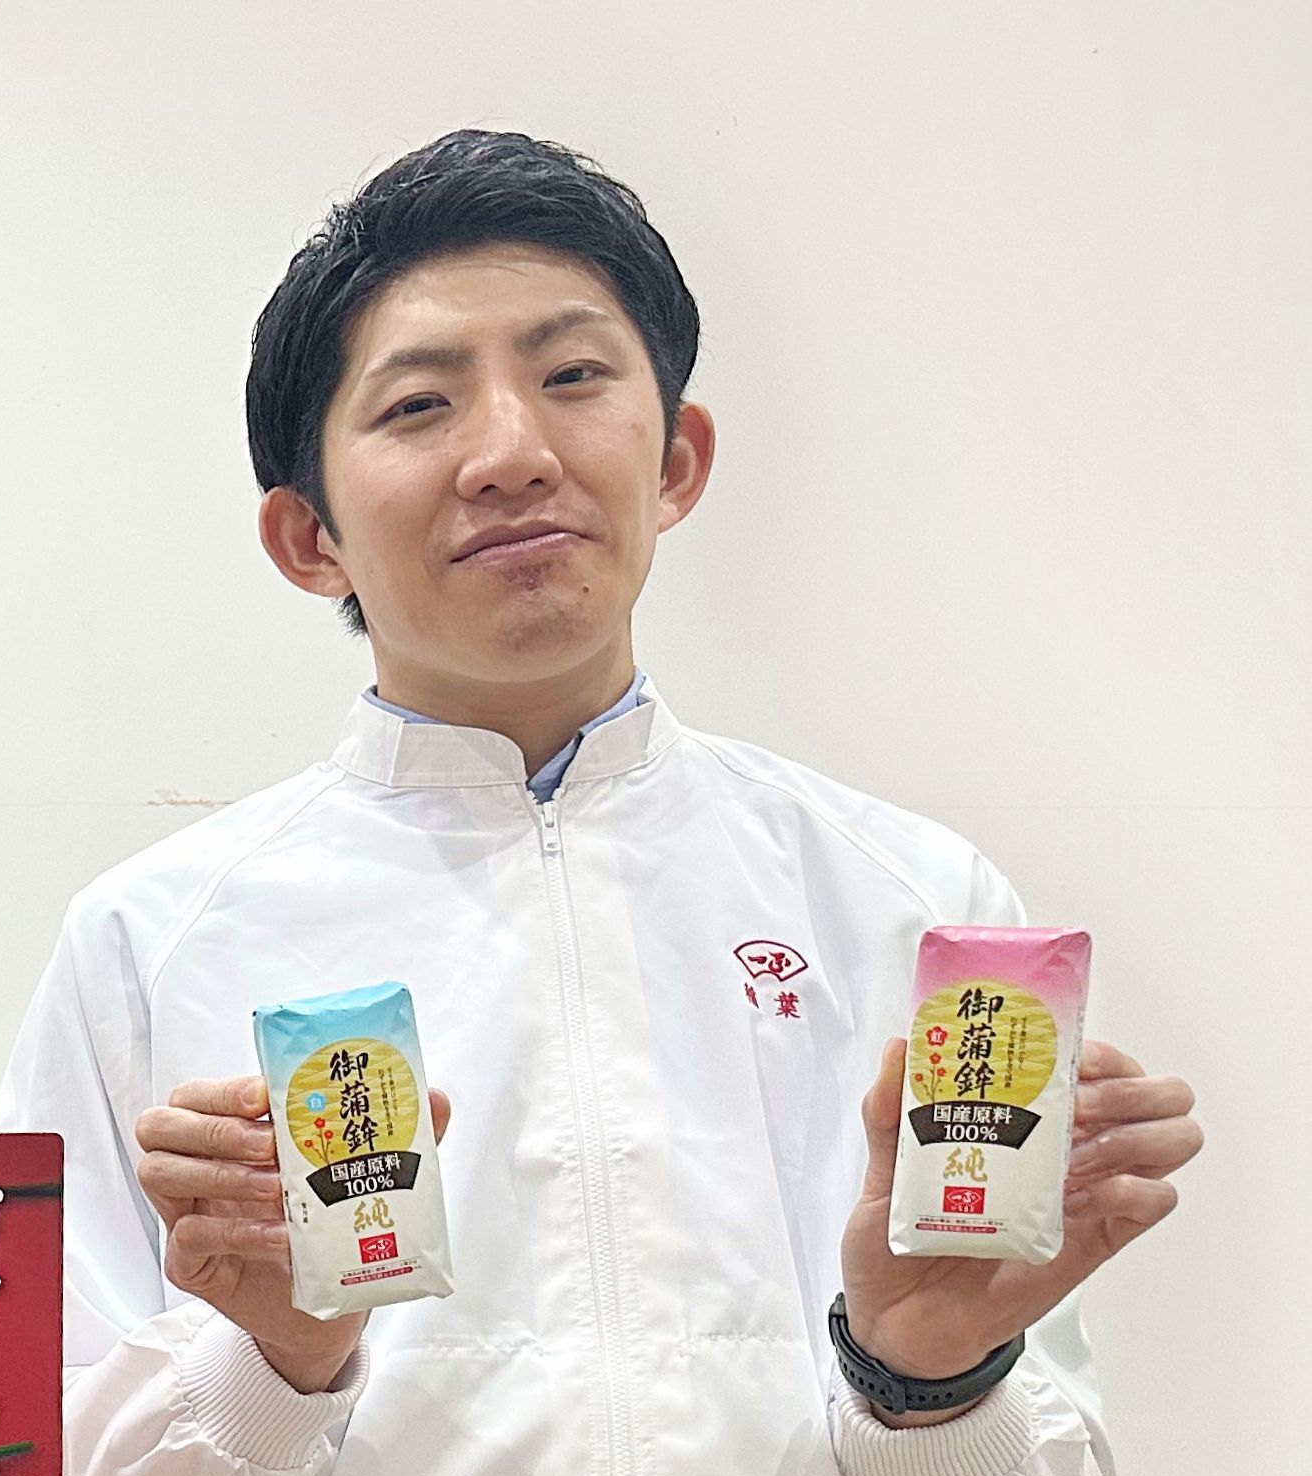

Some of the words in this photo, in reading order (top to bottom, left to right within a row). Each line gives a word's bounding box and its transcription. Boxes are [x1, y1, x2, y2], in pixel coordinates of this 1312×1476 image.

[954, 987, 1004, 1099] 御蒲鉾
[329, 1049, 379, 1153] 御蒲鉾
[933, 1104, 1013, 1125] 国産原料
[944, 1124, 998, 1141] 100%
[330, 1152, 401, 1182] 国産原料
[943, 1146, 988, 1182] 純
[344, 1173, 395, 1197] 100%
[353, 1197, 395, 1233] 純
